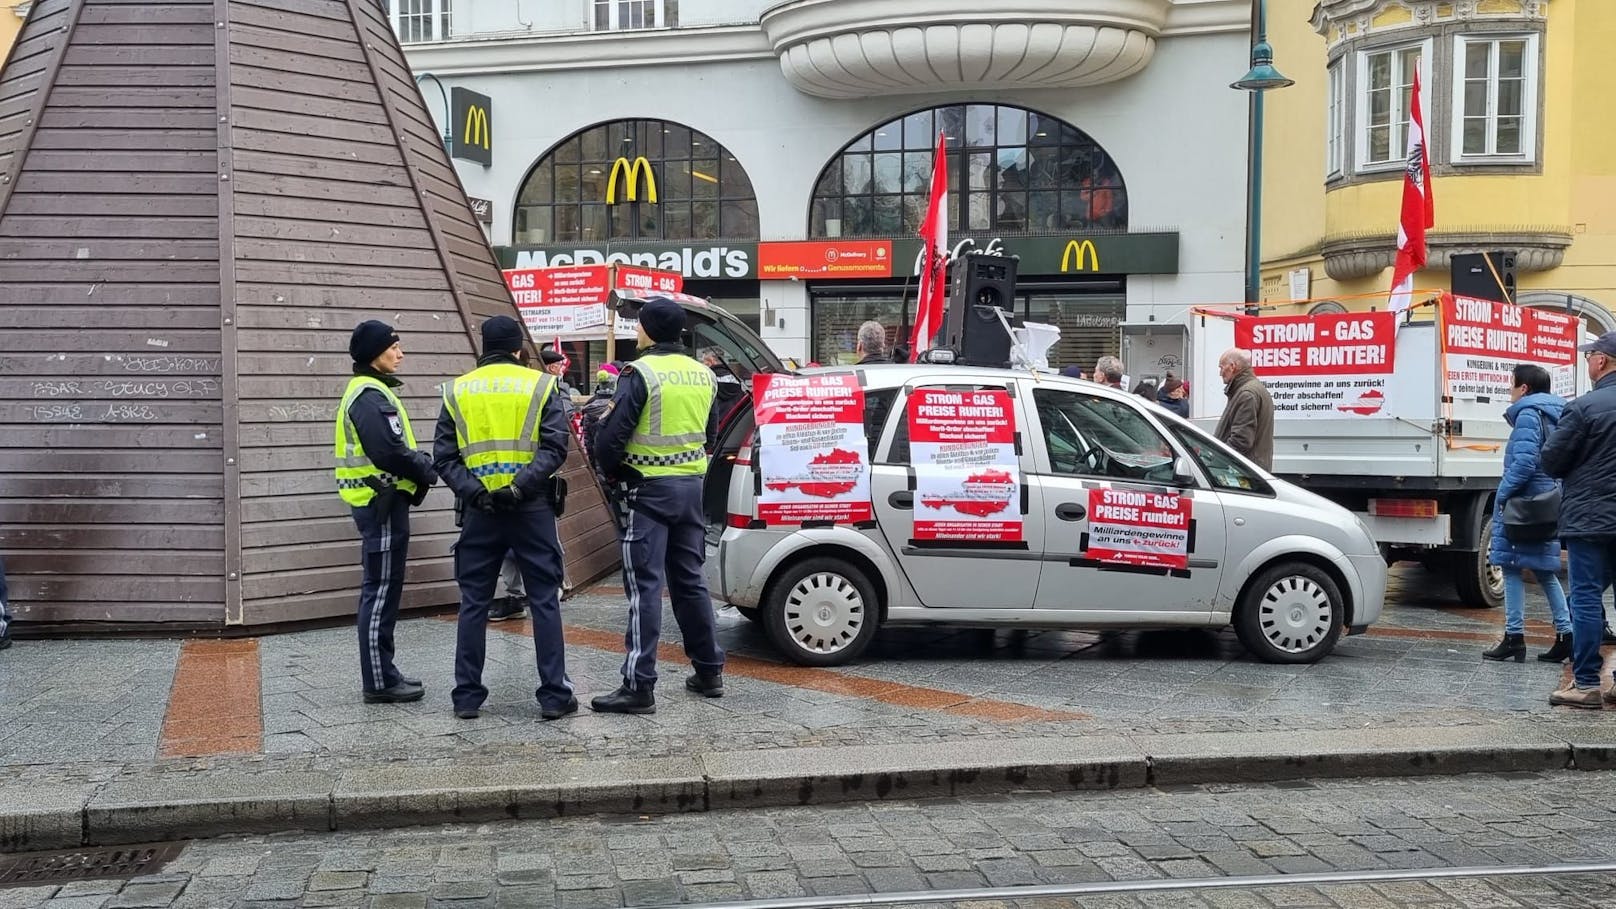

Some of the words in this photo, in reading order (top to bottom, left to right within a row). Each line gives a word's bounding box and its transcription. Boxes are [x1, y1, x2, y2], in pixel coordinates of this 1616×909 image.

[764, 265, 776, 273] Wir
[512, 274, 535, 289] GAS
[625, 274, 653, 289] STROM
[659, 278, 675, 291] GAS
[512, 289, 542, 304] NTER!
[1456, 299, 1492, 323] STROM
[1502, 305, 1522, 328] GAS
[1253, 322, 1315, 344] STROM
[1335, 320, 1374, 341] GAS
[1448, 325, 1484, 349] PREISE
[1486, 329, 1528, 354] RUNTER!
[1306, 345, 1386, 366] RUNTER!
[656, 370, 711, 386] POLIZEI
[771, 377, 810, 388] STROM
[820, 376, 844, 386] GAS
[1261, 380, 1322, 390] liardengewinne
[1353, 379, 1385, 388] zurück!
[457, 376, 534, 396] POLIZEI
[764, 387, 803, 400] PREISE
[806, 386, 852, 398] RUNTER!
[925, 393, 963, 405] STROM
[973, 395, 995, 406] GAS
[1271, 391, 1295, 400] -Order
[1297, 391, 1344, 400] abschaffen!
[918, 406, 956, 417] PREISE
[959, 406, 1004, 418] RUNTER!
[1274, 403, 1298, 411] ackout
[1300, 402, 1333, 411] sichern!
[1095, 505, 1139, 521] PREISE
[1142, 510, 1184, 525] runter!
[1093, 526, 1185, 541] Milliardengewinne
[1113, 537, 1131, 545] uns
[1142, 539, 1180, 548] zurück!
